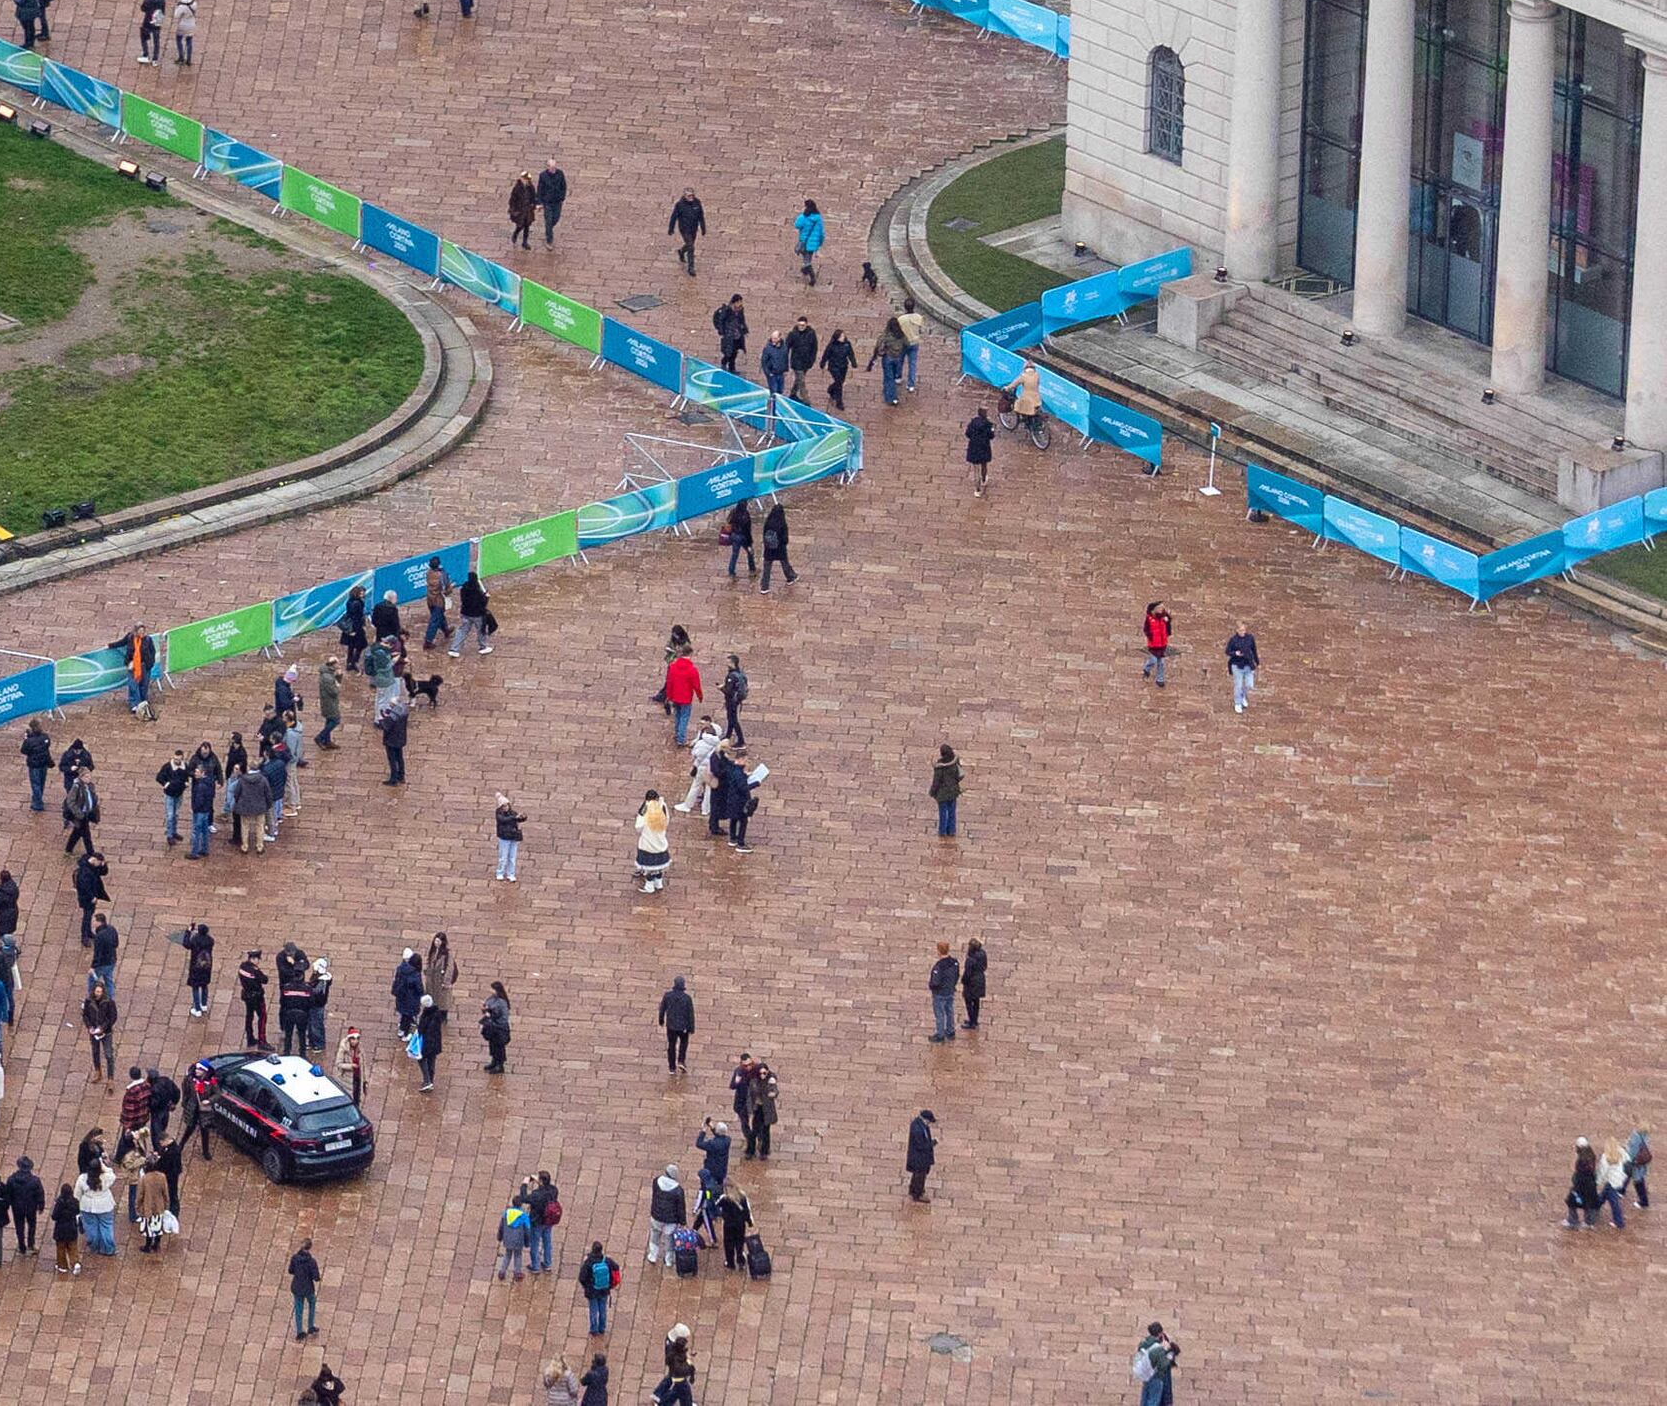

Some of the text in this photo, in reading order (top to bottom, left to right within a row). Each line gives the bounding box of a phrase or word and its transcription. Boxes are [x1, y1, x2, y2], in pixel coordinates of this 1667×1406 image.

[705, 470, 738, 486] MILANO
[710, 477, 744, 493] CORTINA
[403, 561, 430, 575] MILAN
[1493, 549, 1552, 574] MILANO CORTINA
[408, 569, 428, 582] CORT
[200, 620, 236, 637] MILANO
[205, 627, 242, 644] CORTINA
[214, 1102, 257, 1139] CARABINIERI
